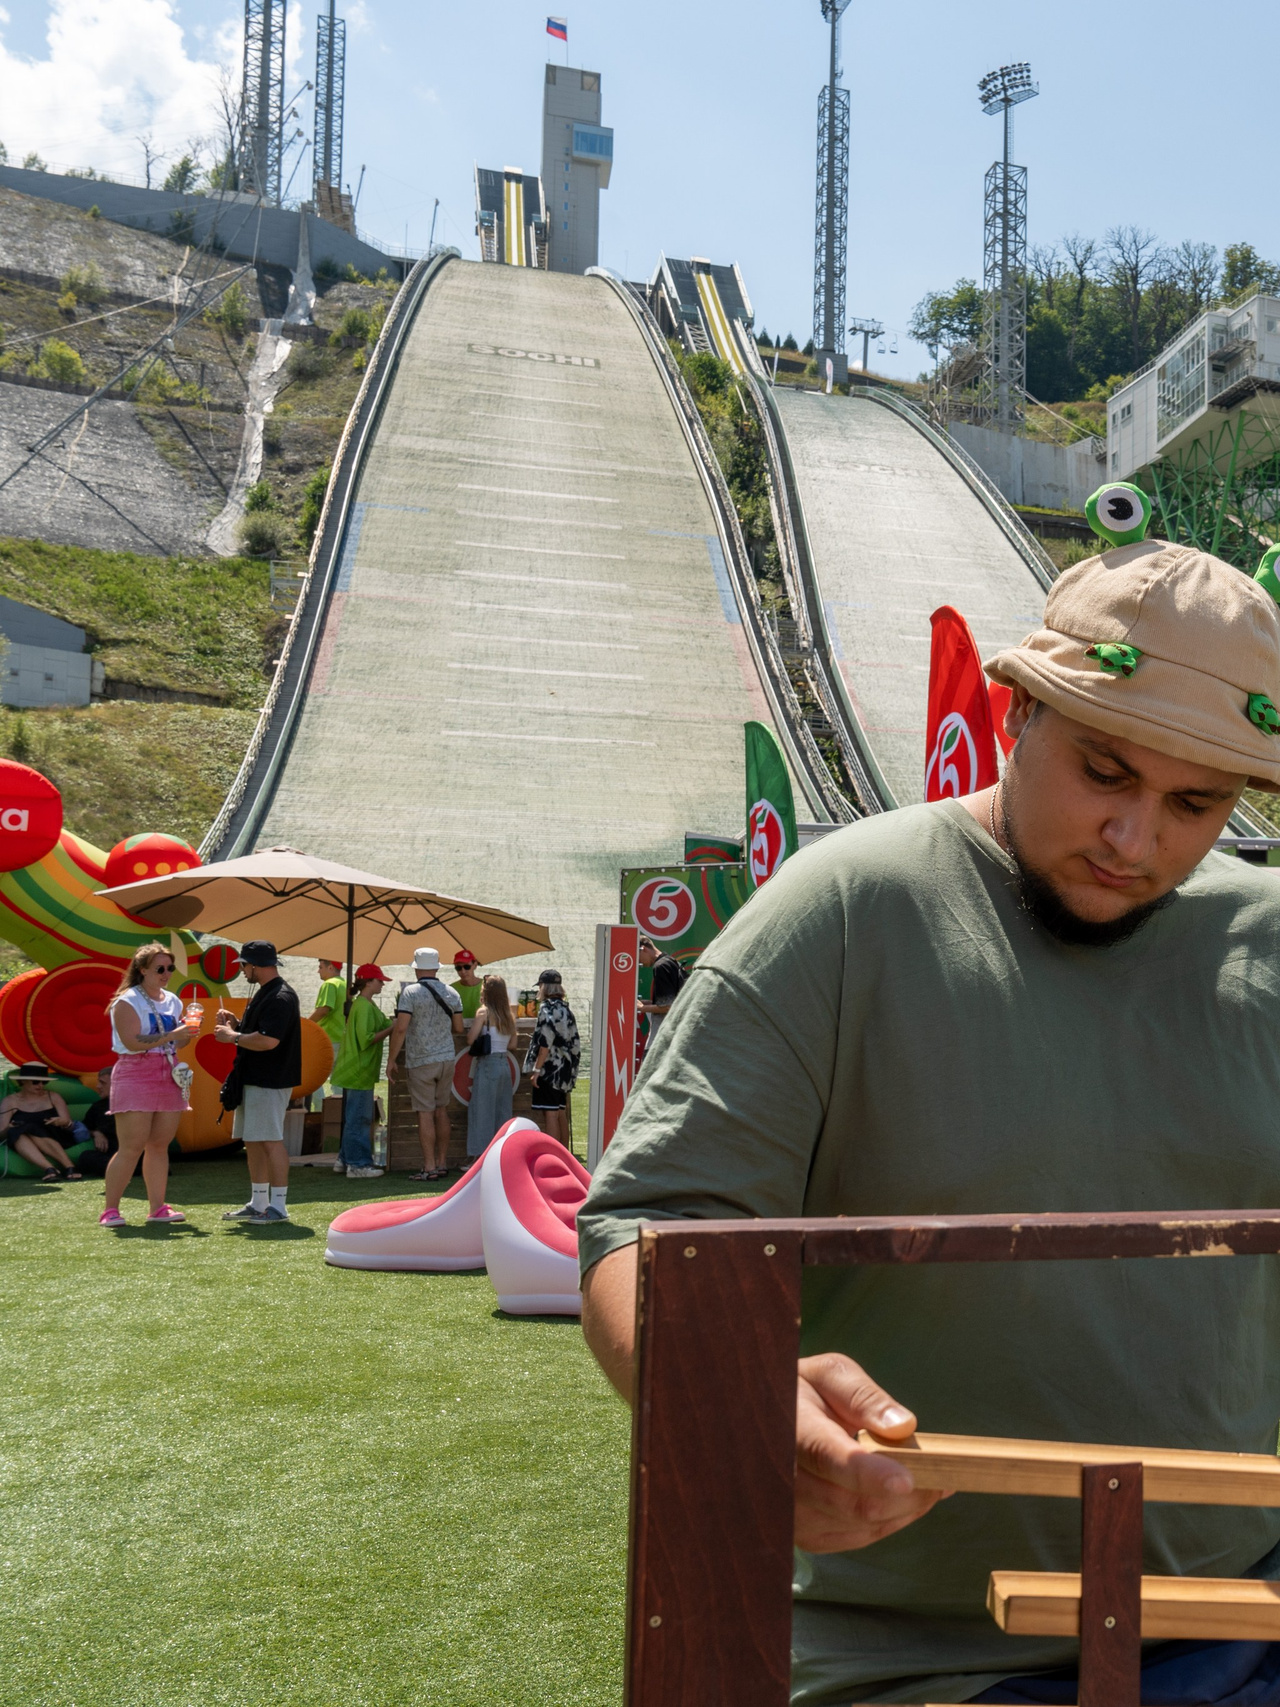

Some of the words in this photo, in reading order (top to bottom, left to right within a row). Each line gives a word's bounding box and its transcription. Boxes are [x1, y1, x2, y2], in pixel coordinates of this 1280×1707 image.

[471, 344, 596, 367] SOCHI
[752, 804, 769, 877] 5
[648, 882, 684, 929] 5
[618, 954, 629, 969] 5
